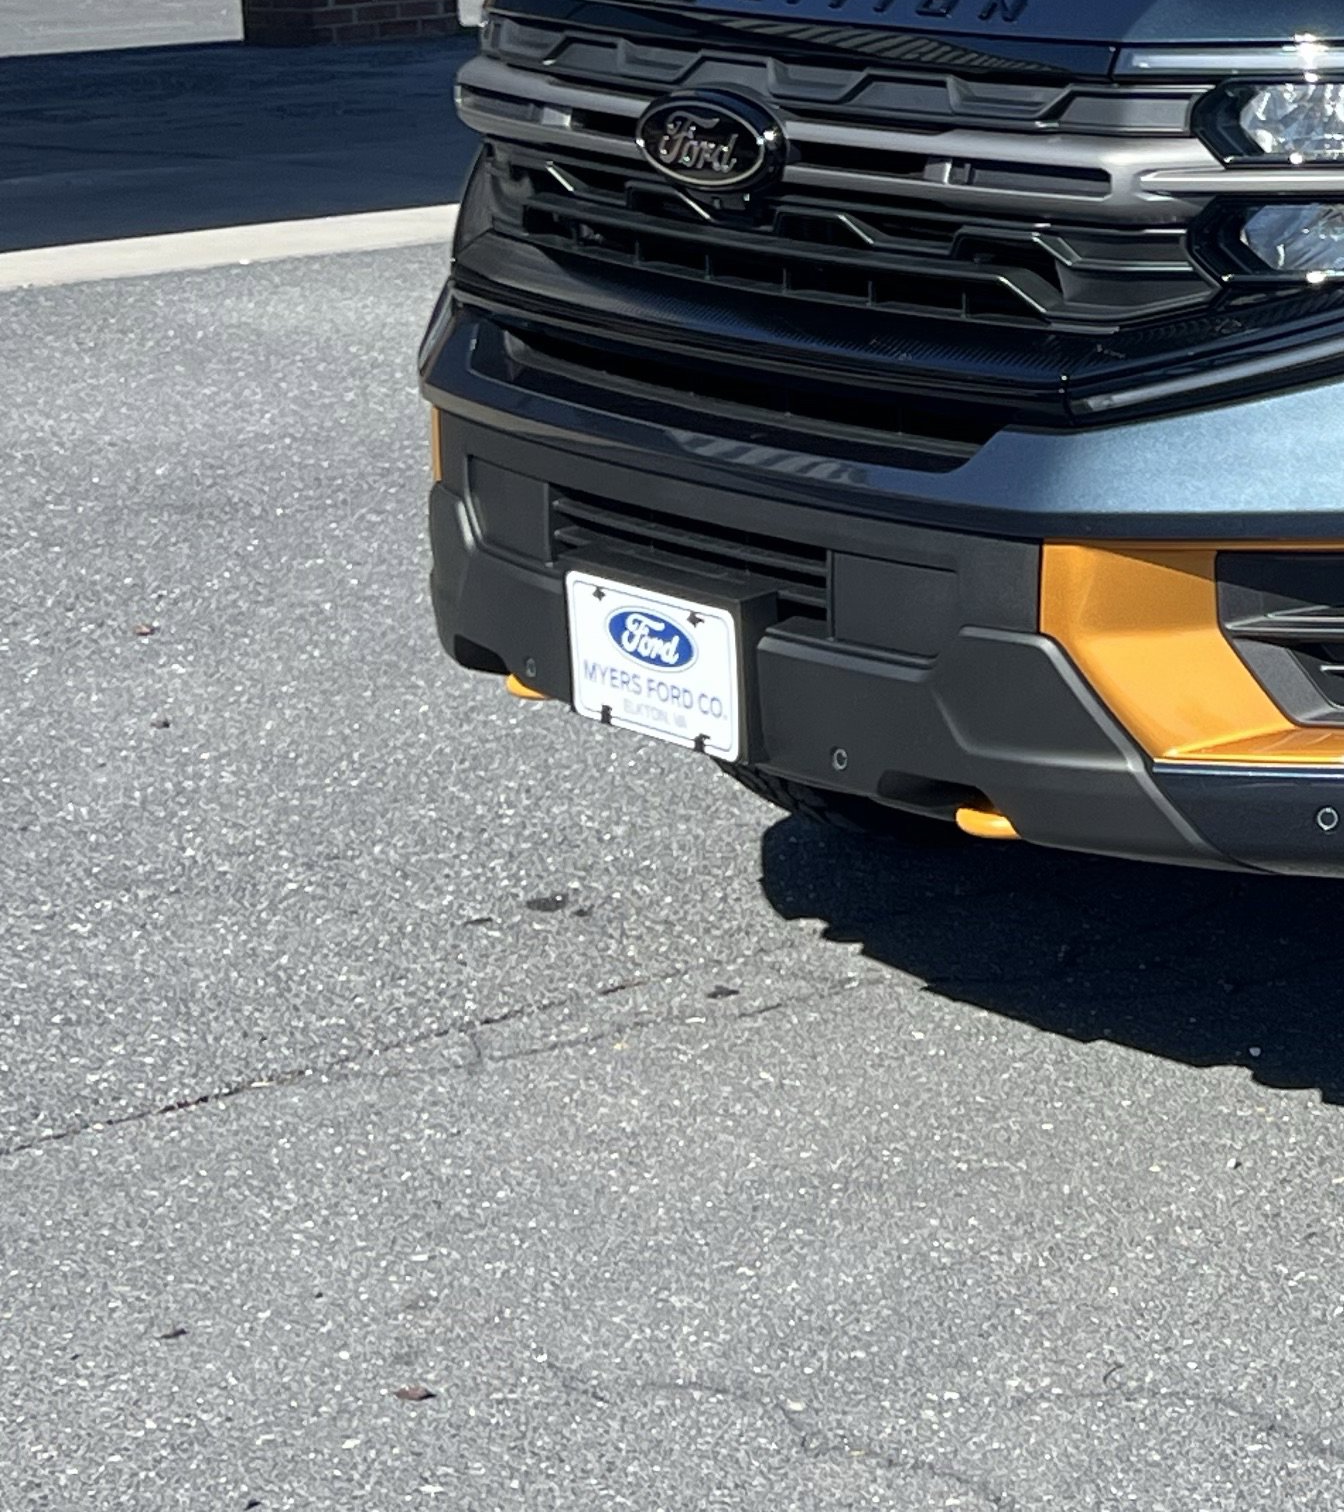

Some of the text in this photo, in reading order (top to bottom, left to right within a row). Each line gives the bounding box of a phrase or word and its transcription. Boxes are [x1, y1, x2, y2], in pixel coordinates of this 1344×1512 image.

[659, 110, 738, 173] Ford
[621, 612, 680, 665] Ford
[583, 659, 728, 721] MYERS FORD CO.
